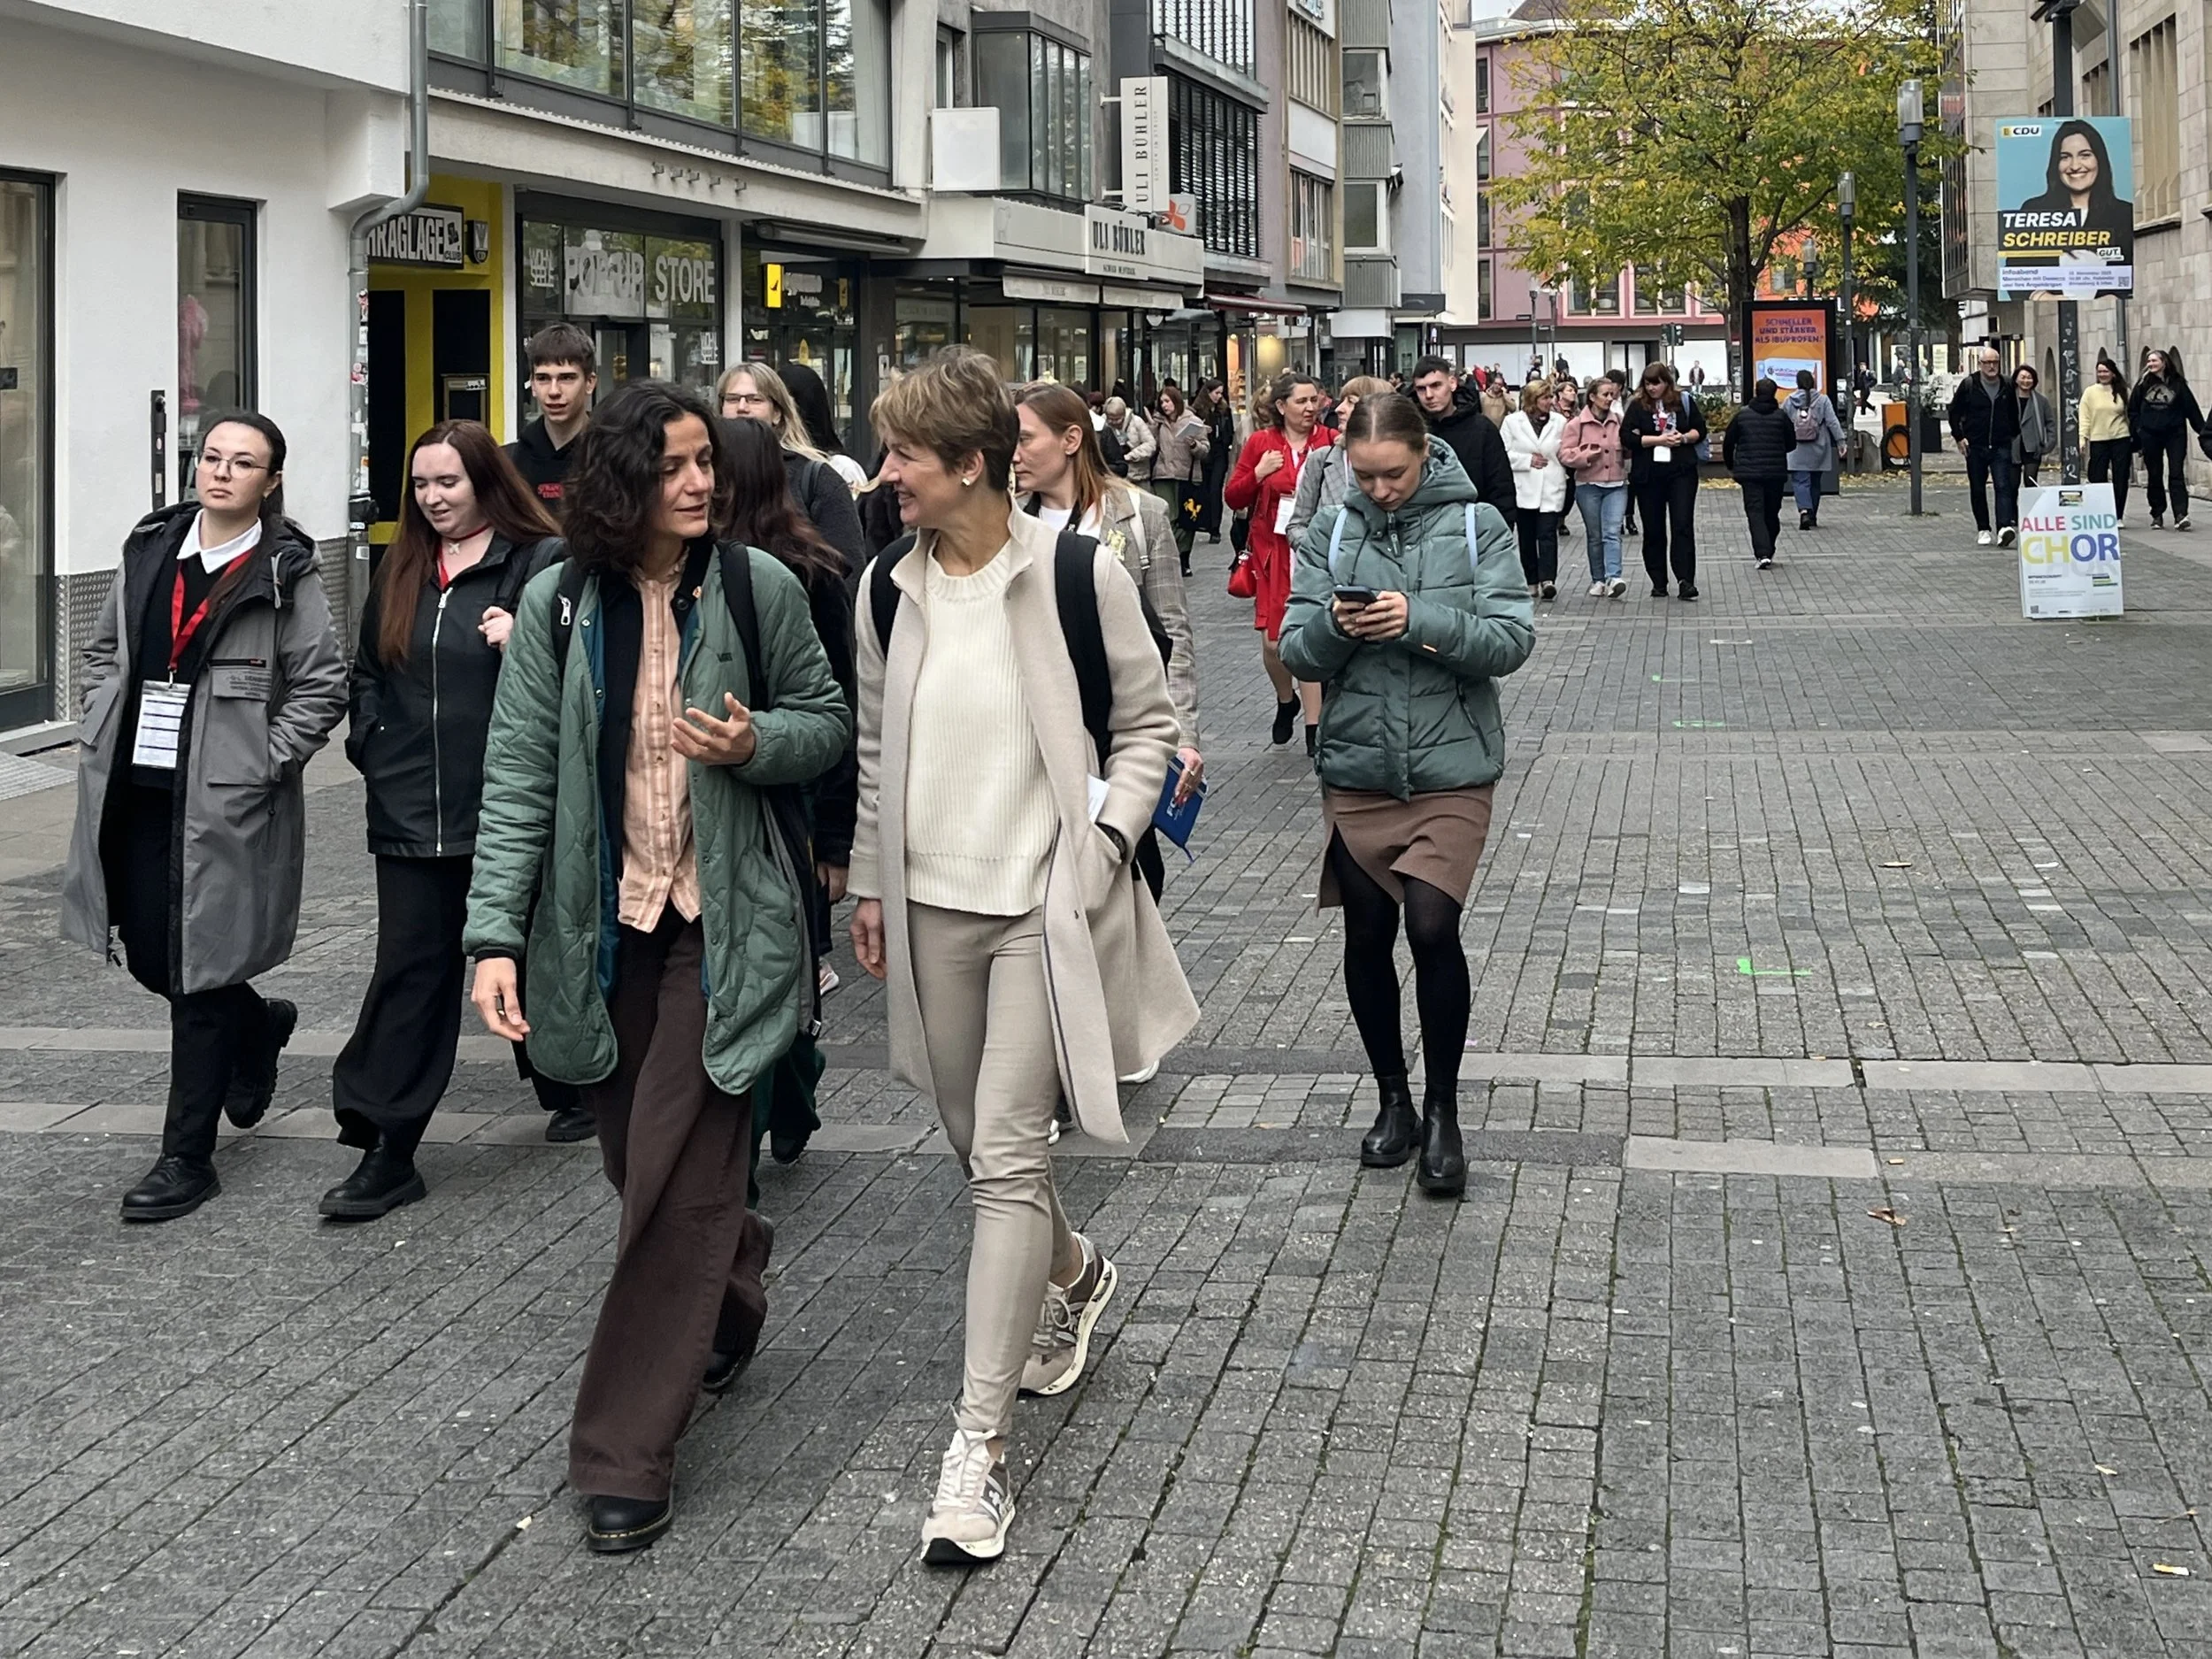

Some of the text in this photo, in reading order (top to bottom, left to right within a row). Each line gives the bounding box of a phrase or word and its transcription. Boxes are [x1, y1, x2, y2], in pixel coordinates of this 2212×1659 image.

[2013, 127, 2039, 135] CDU
[1133, 86, 1148, 204] ULI BÜHLER
[2003, 211, 2077, 228] TERESA
[1093, 219, 1145, 255] ULI BÜHLER
[2002, 230, 2111, 248] SCHREIBER
[655, 255, 716, 303] STORE
[1780, 326, 1816, 334] STÄRKER
[2021, 514, 2117, 532] ALLE SIND
[2021, 534, 2121, 565] CHOR
